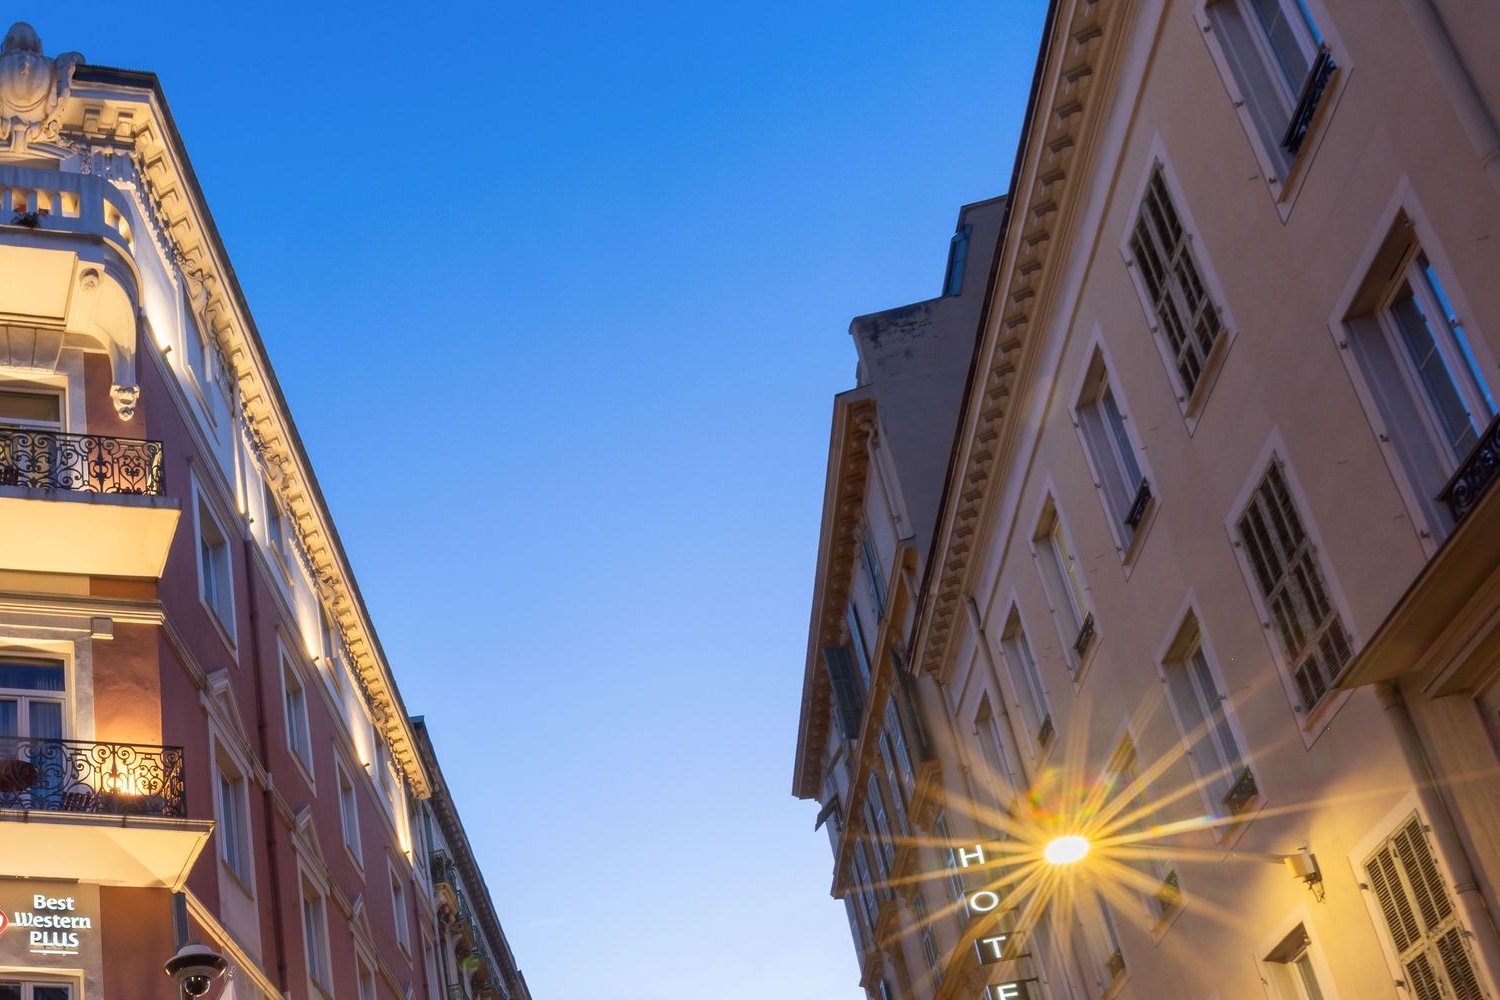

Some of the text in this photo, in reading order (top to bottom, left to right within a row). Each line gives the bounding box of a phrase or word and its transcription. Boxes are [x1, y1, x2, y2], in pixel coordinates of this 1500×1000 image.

[33, 894, 75, 911] Best
[14, 912, 92, 929] Western
[29, 930, 80, 948] PLUS
